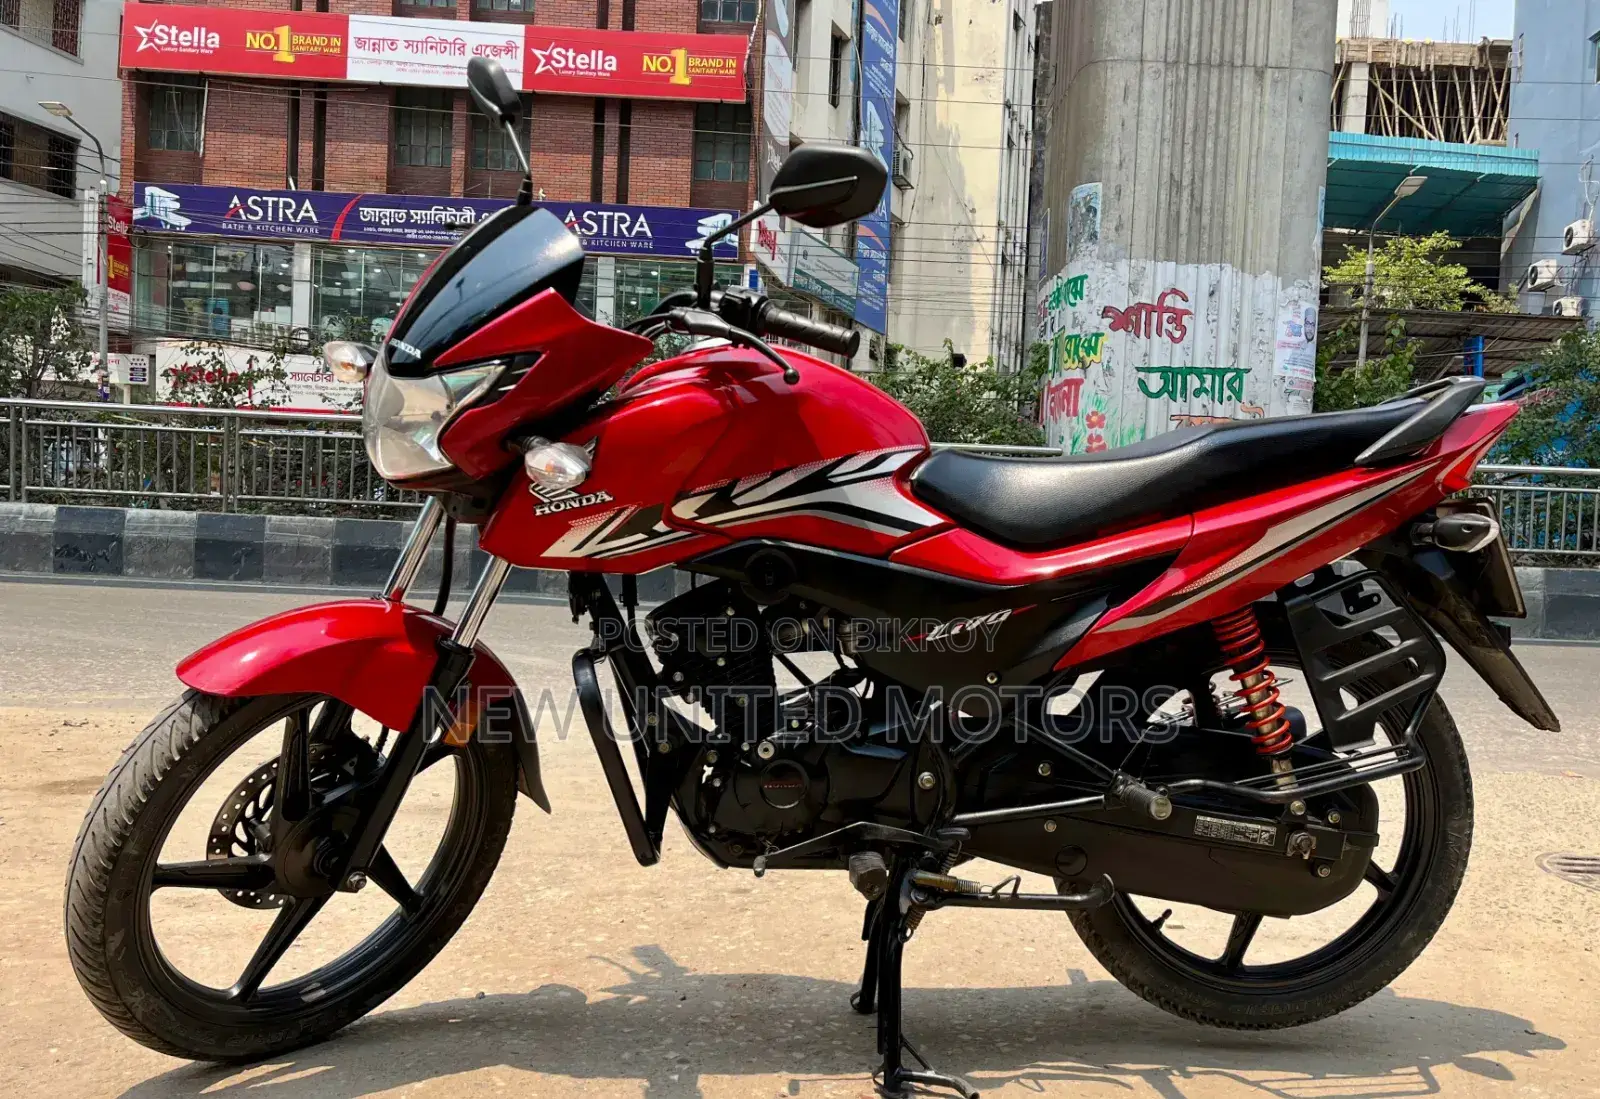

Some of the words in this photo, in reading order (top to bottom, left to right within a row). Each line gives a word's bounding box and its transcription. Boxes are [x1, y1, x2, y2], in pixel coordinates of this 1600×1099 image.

[154, 24, 220, 49] Stella
[292, 35, 327, 46] BRAND
[329, 37, 341, 47] IN
[354, 36, 399, 54] জান্নাত
[403, 35, 467, 57] স্যানিটারি
[178, 46, 200, 54] Sanitary
[292, 44, 322, 53] SANITARY
[551, 47, 617, 72] Stella
[688, 58, 723, 68] BRAND
[725, 58, 736, 68] IN
[687, 66, 718, 75] SANITARY
[224, 194, 319, 223] ASTRA
[359, 206, 408, 226] জান্নাত
[256, 224, 293, 232] KITCHEN
[564, 209, 653, 239] ASTRA
[591, 240, 627, 248] KITCHEN
[630, 241, 653, 249] WARE
[1101, 287, 1194, 344] শান্তি
[1135, 366, 1252, 404] আমার
[533, 490, 614, 517] HONDA
